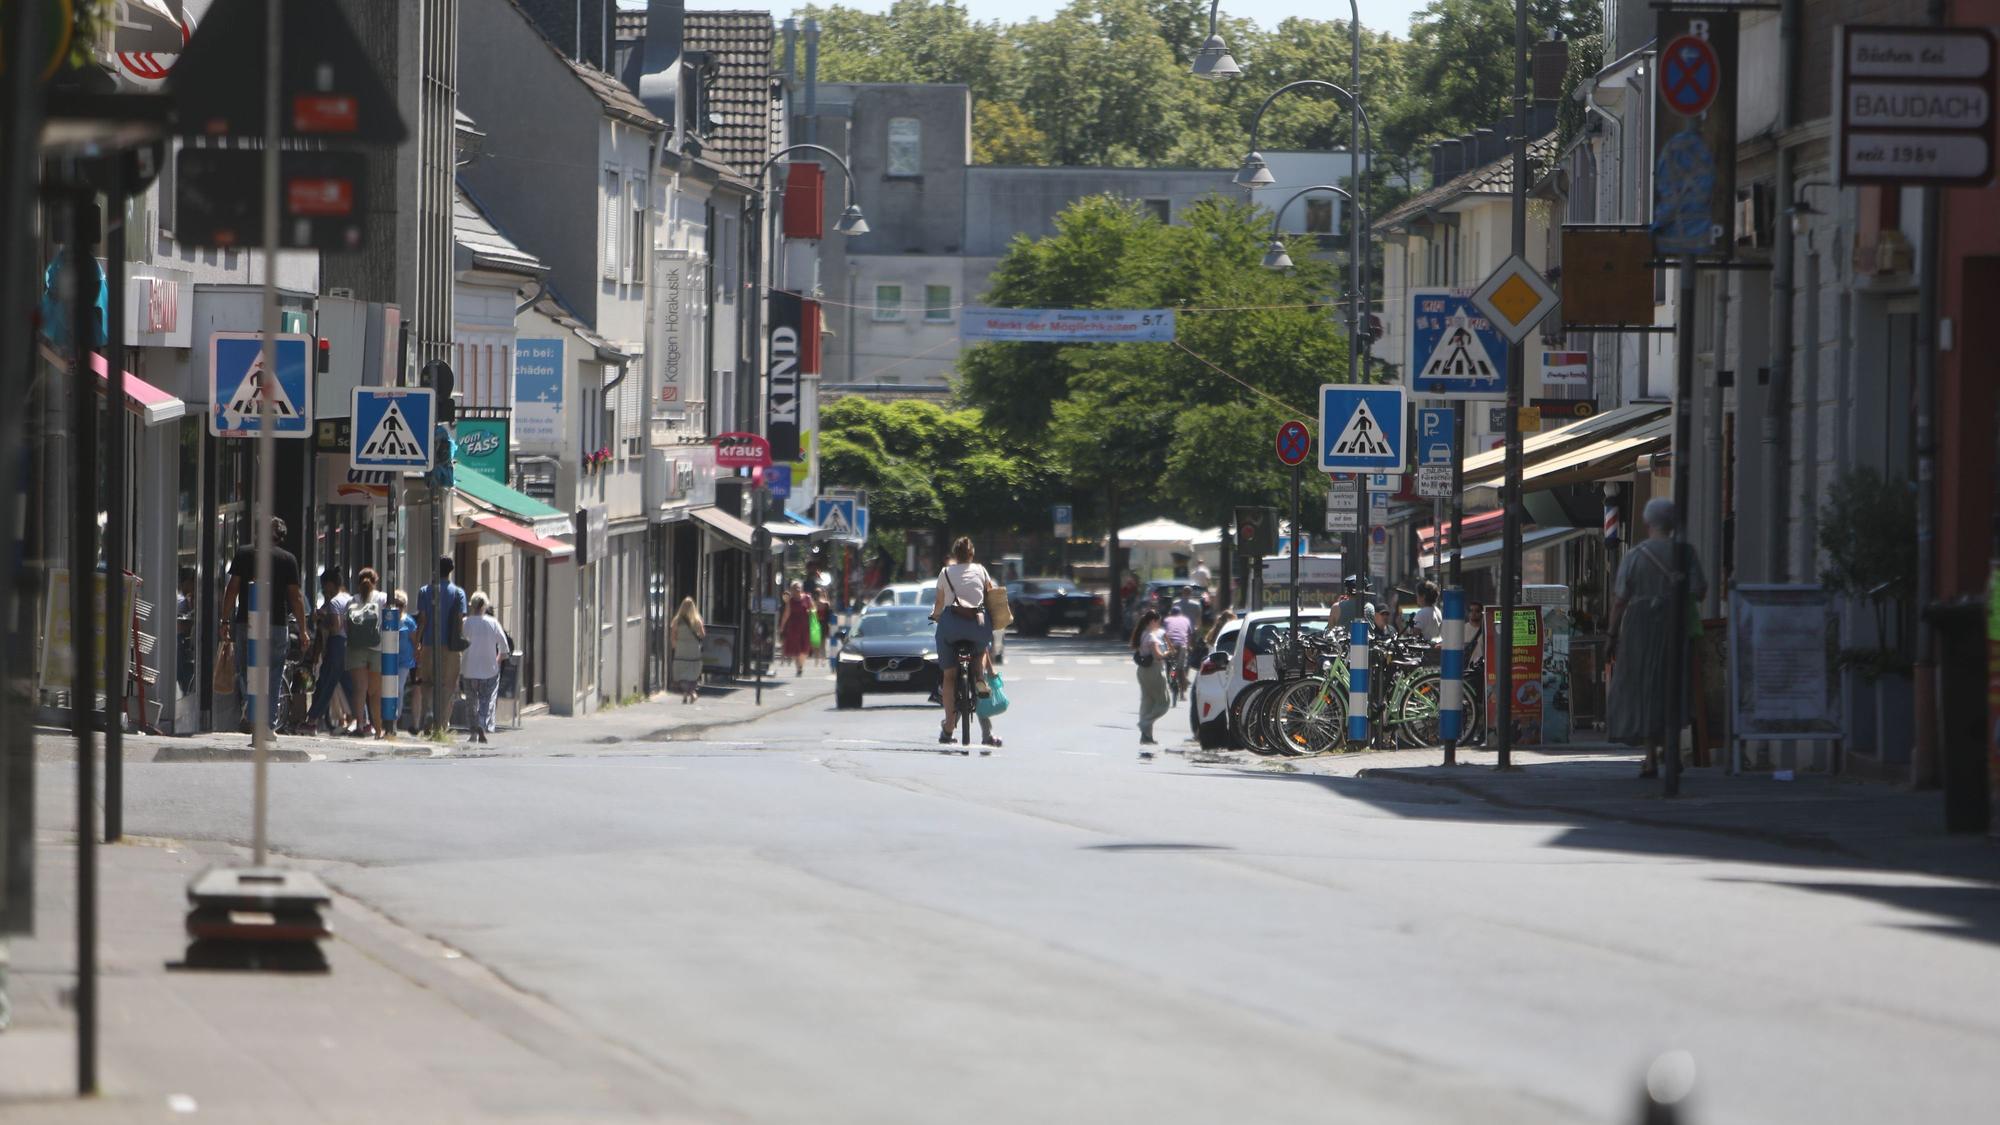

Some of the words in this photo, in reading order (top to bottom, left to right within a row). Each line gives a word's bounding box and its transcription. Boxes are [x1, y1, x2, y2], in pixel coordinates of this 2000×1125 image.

[1856, 96, 1981, 118] BAUDACH
[665, 267, 679, 333] Hörakustik
[987, 319, 1022, 331] Markt
[1026, 320, 1046, 331] der
[665, 336, 681, 383] Köttgen
[770, 326, 798, 425] KIND
[1424, 412, 1440, 436] P
[466, 436, 499, 456] FASS
